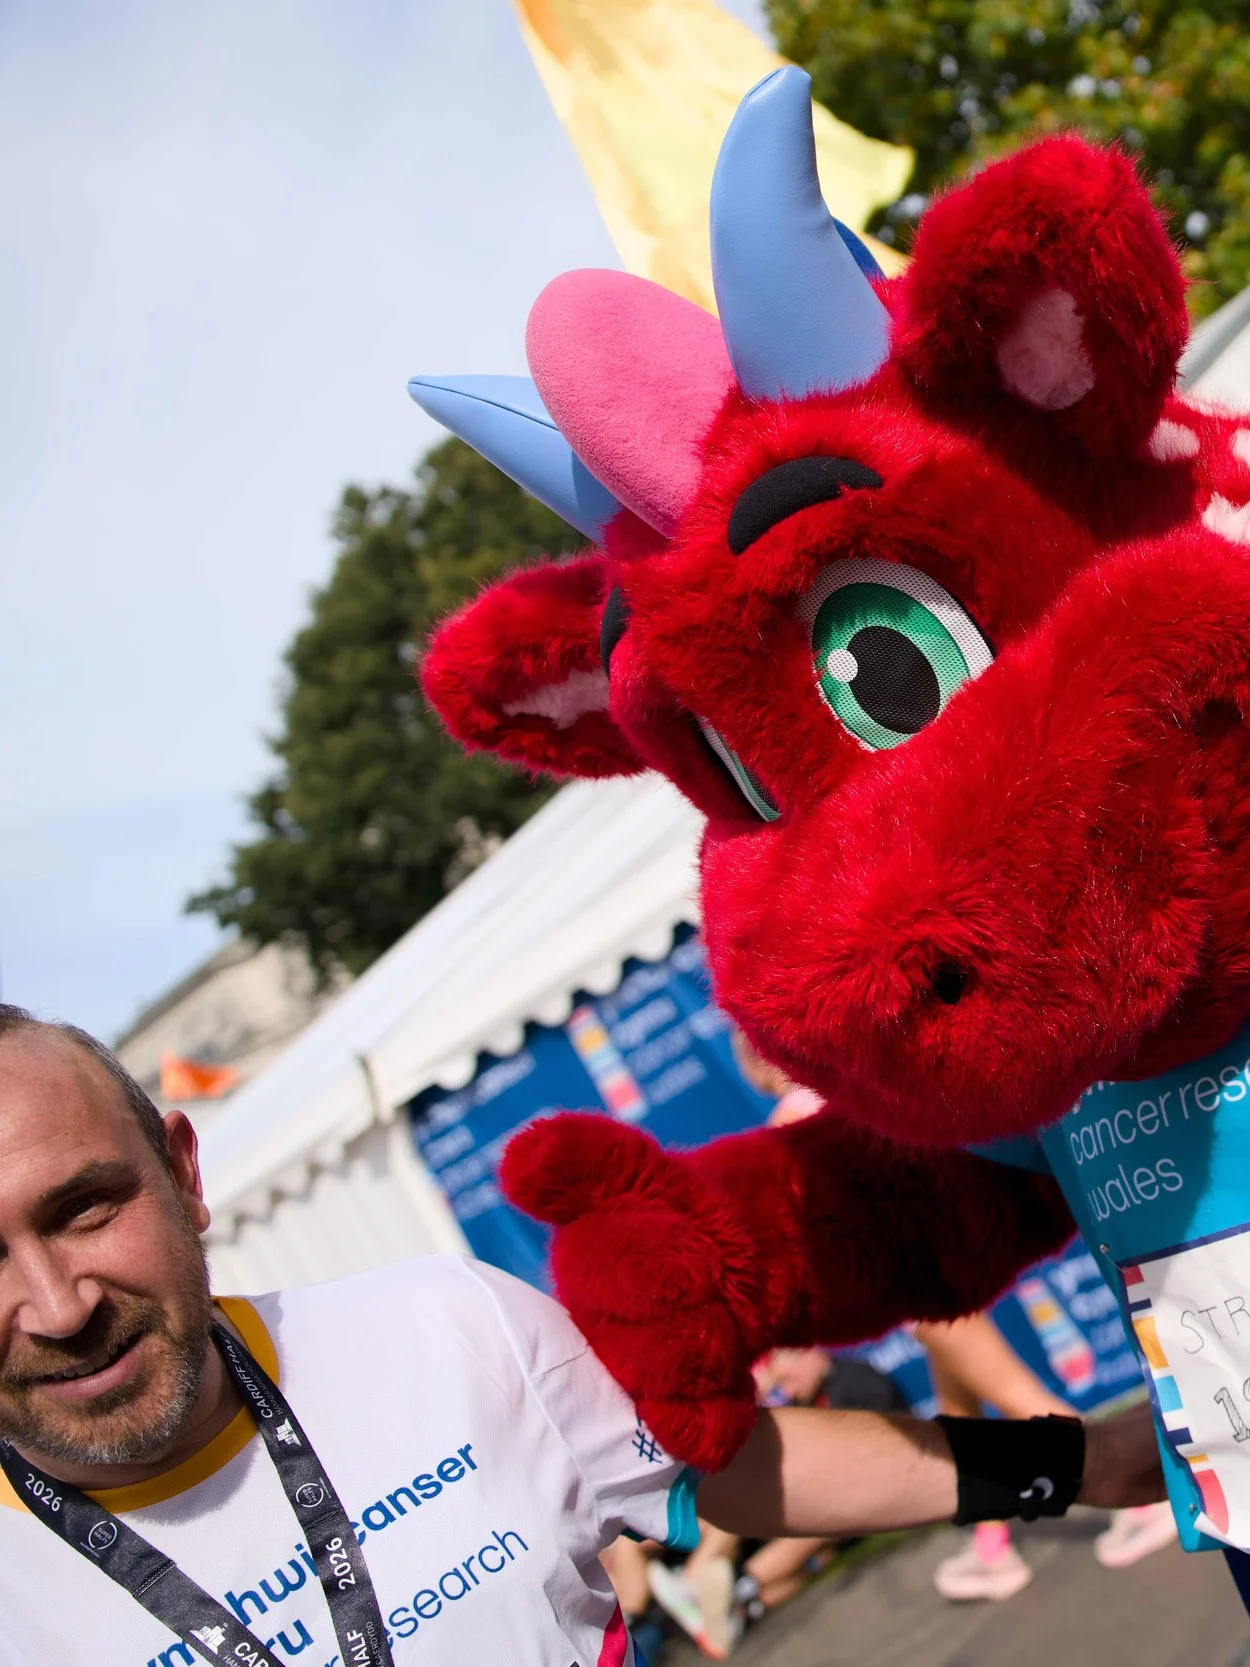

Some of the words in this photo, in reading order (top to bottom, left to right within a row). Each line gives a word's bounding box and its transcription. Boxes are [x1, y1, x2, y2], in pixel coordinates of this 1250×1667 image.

[1087, 1157, 1184, 1222] wales
[234, 1364, 274, 1419] CARDIFF
[24, 1472, 63, 1512] 2026
[325, 1537, 356, 1590] 2026
[365, 1620, 384, 1666] CAERDYDD
